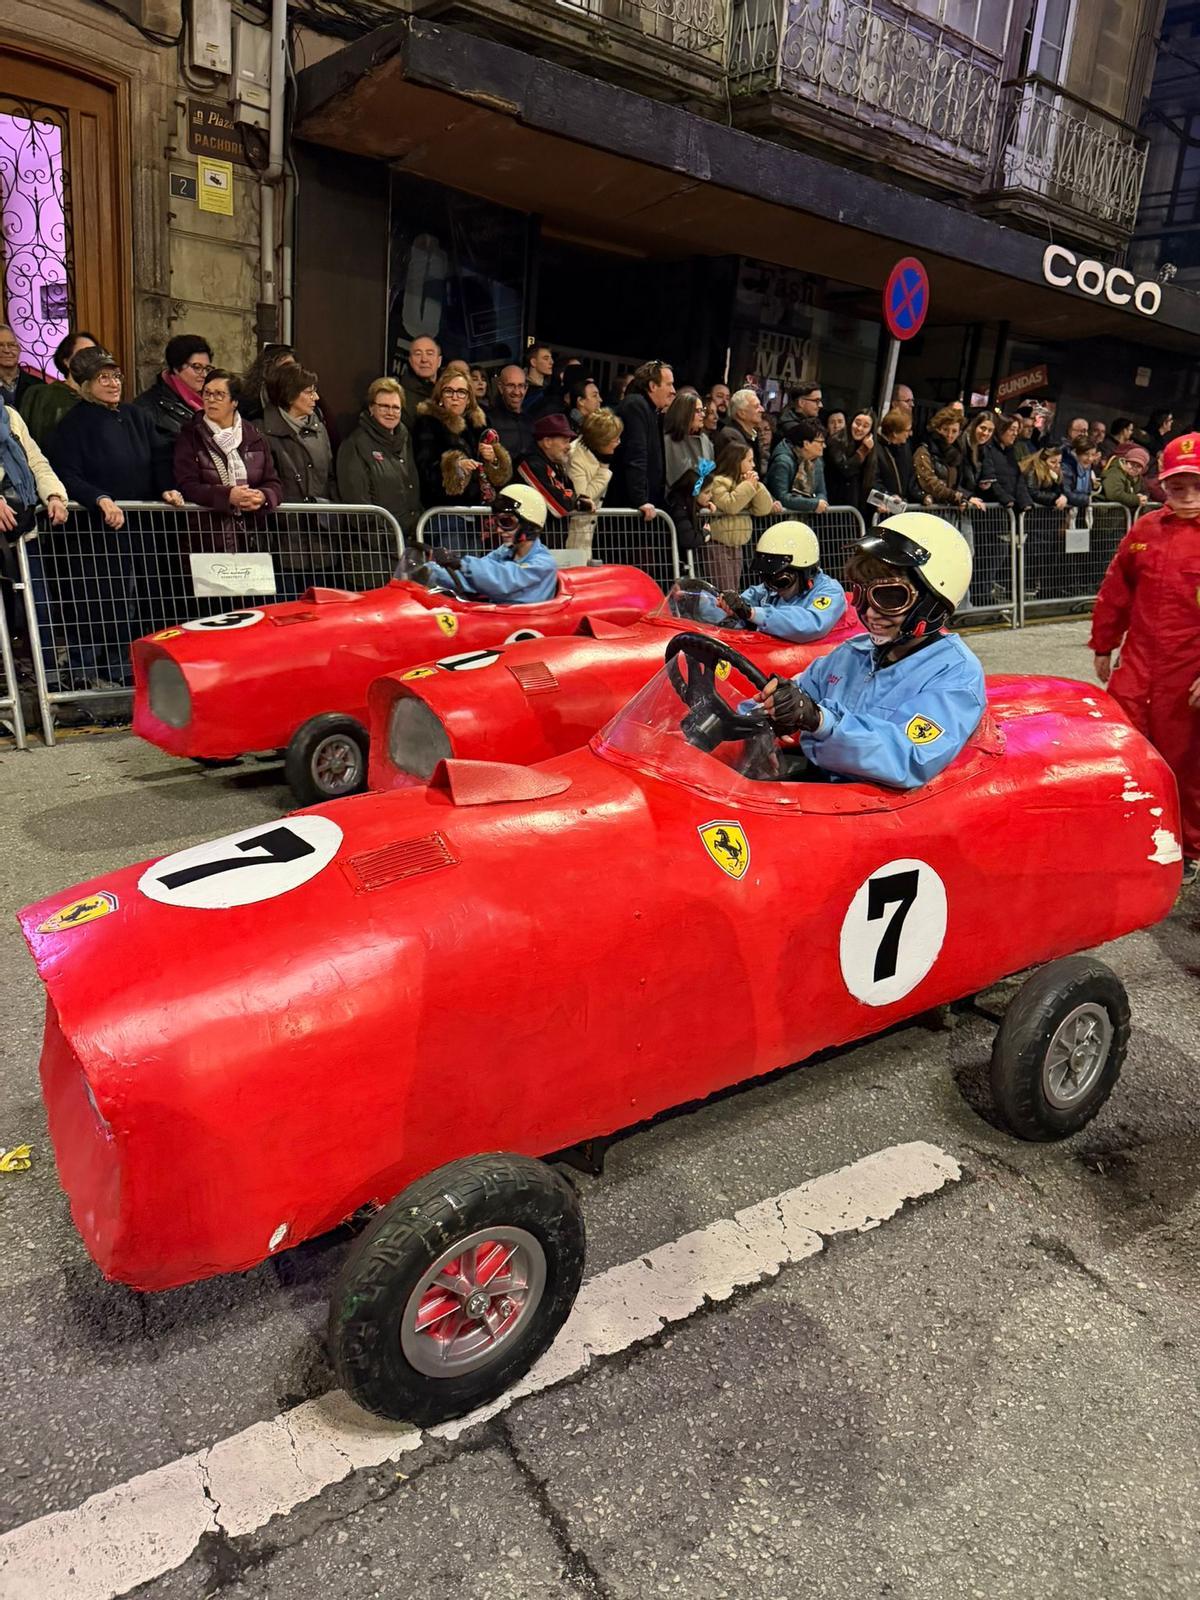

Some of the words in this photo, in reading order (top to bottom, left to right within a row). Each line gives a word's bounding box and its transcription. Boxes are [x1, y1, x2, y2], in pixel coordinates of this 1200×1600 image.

[179, 179, 188, 195] 2
[1043, 244, 1161, 315] COCO
[998, 370, 1043, 396] GUNDAS
[200, 612, 255, 627] 3
[156, 826, 316, 890] 7
[867, 869, 920, 983] 7
